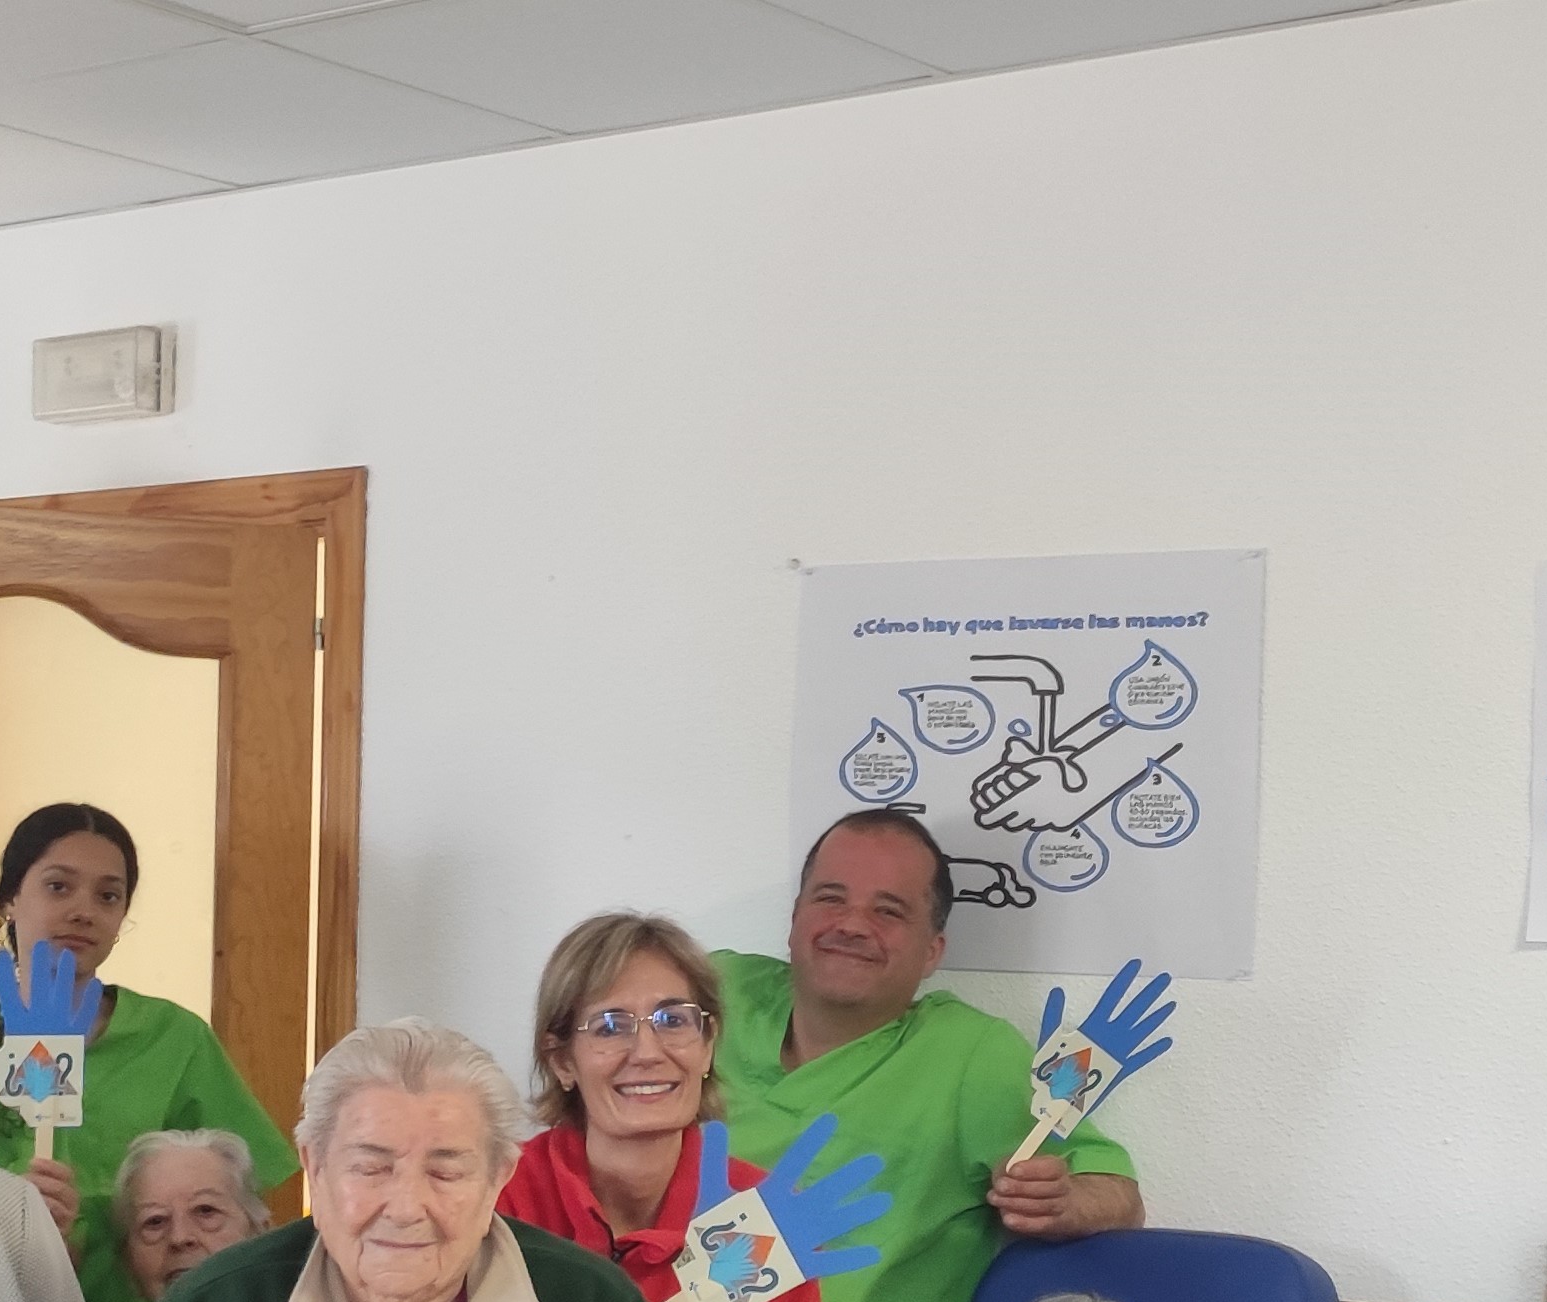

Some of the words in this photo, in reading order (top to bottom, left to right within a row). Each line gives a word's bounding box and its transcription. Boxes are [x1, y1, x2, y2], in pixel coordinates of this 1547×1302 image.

[853, 617, 919, 638] ¿Cómo
[922, 616, 961, 636] hay
[965, 619, 1004, 634] que
[1008, 615, 1085, 631] lavarse
[1088, 613, 1121, 629] las
[1125, 611, 1210, 629] manos?
[1151, 654, 1163, 667] 2
[916, 692, 925, 703] 1
[1152, 773, 1163, 786] 3
[1070, 828, 1081, 840] 4
